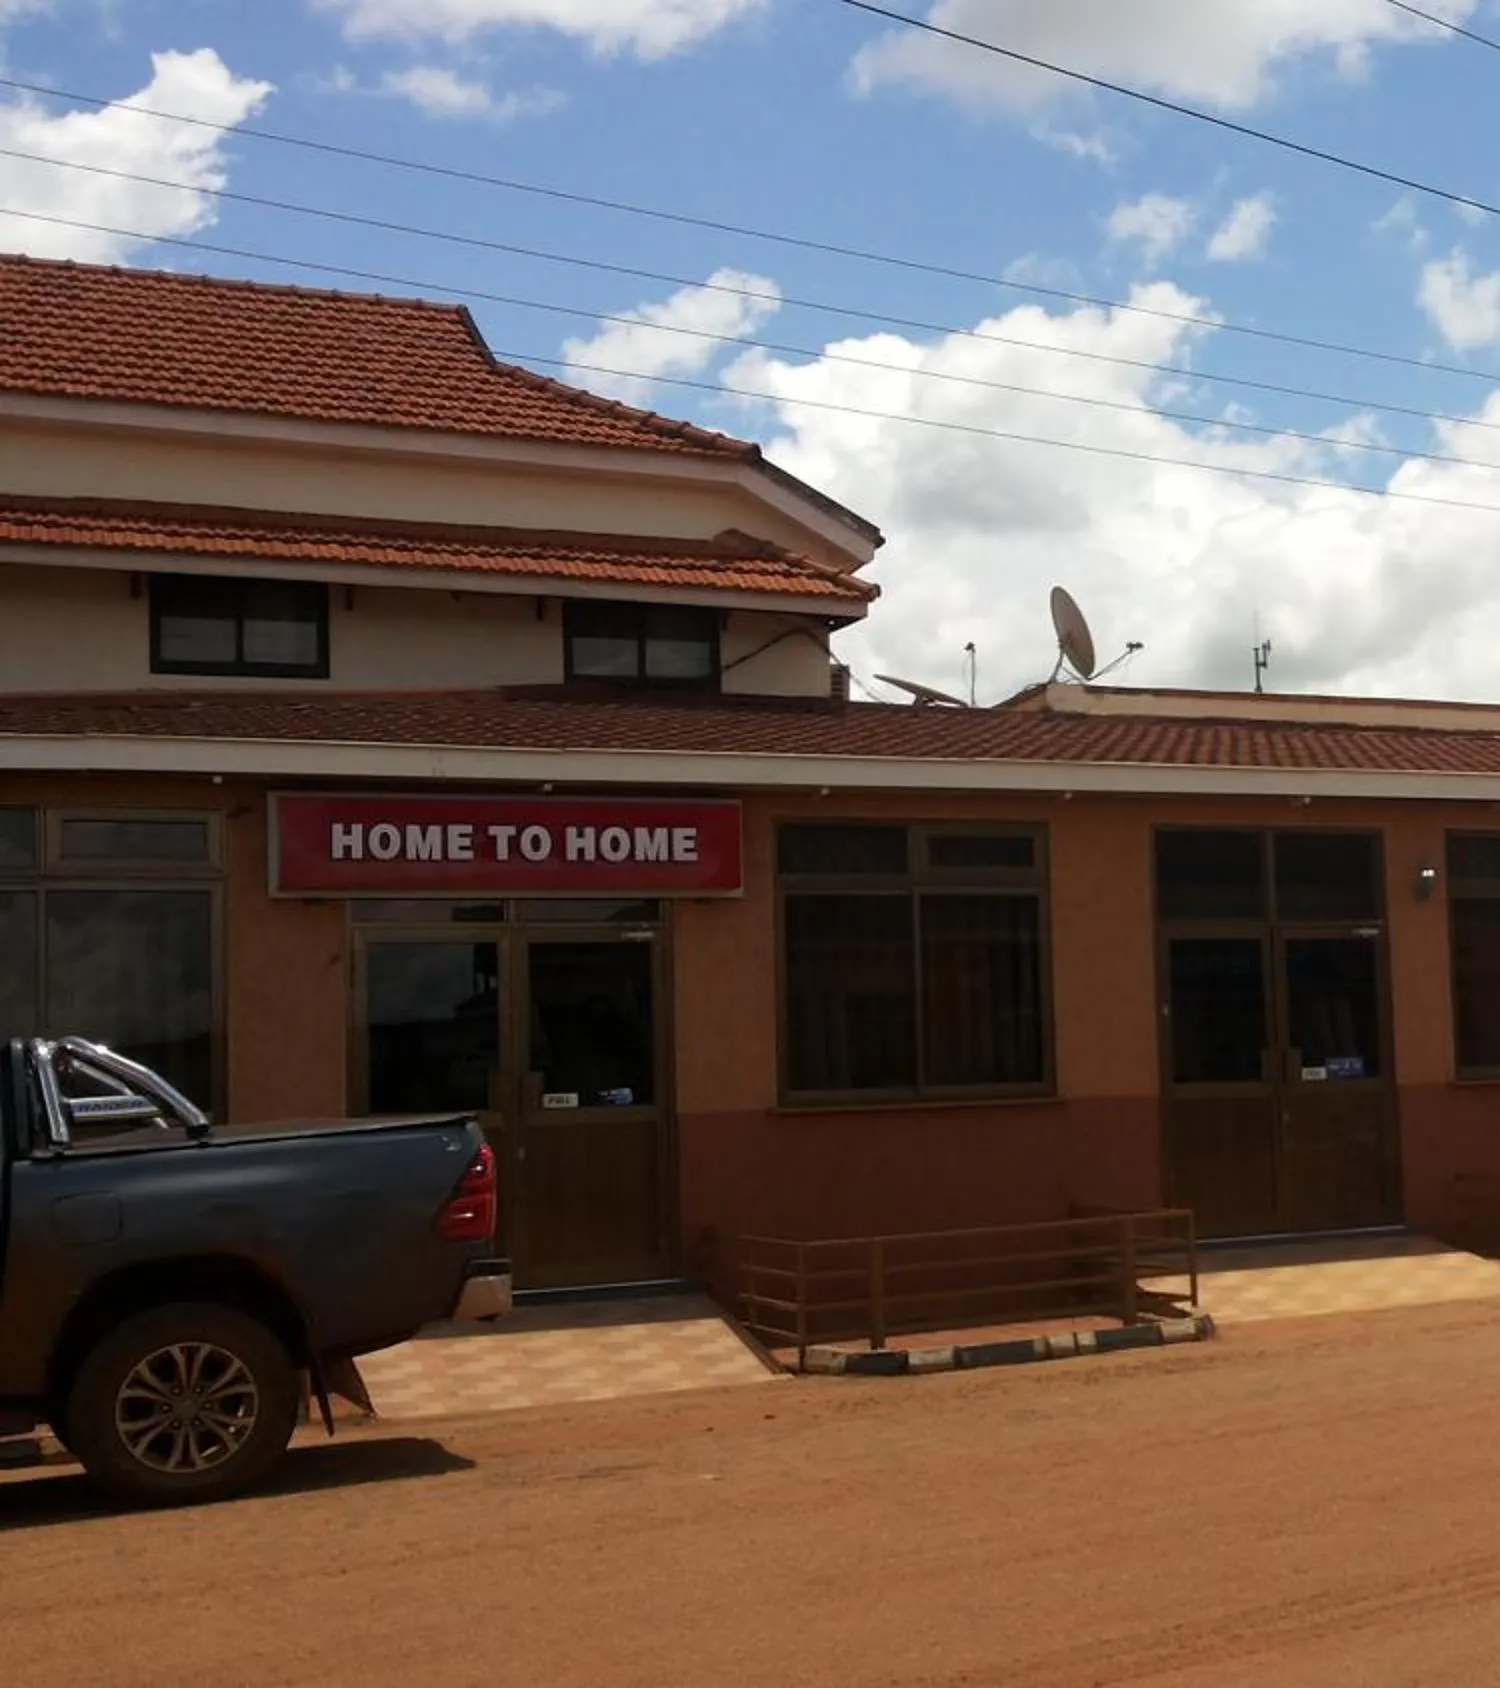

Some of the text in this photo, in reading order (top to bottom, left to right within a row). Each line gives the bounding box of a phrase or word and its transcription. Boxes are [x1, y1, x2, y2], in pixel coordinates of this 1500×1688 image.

[331, 823, 699, 861] HOME TO HOME
